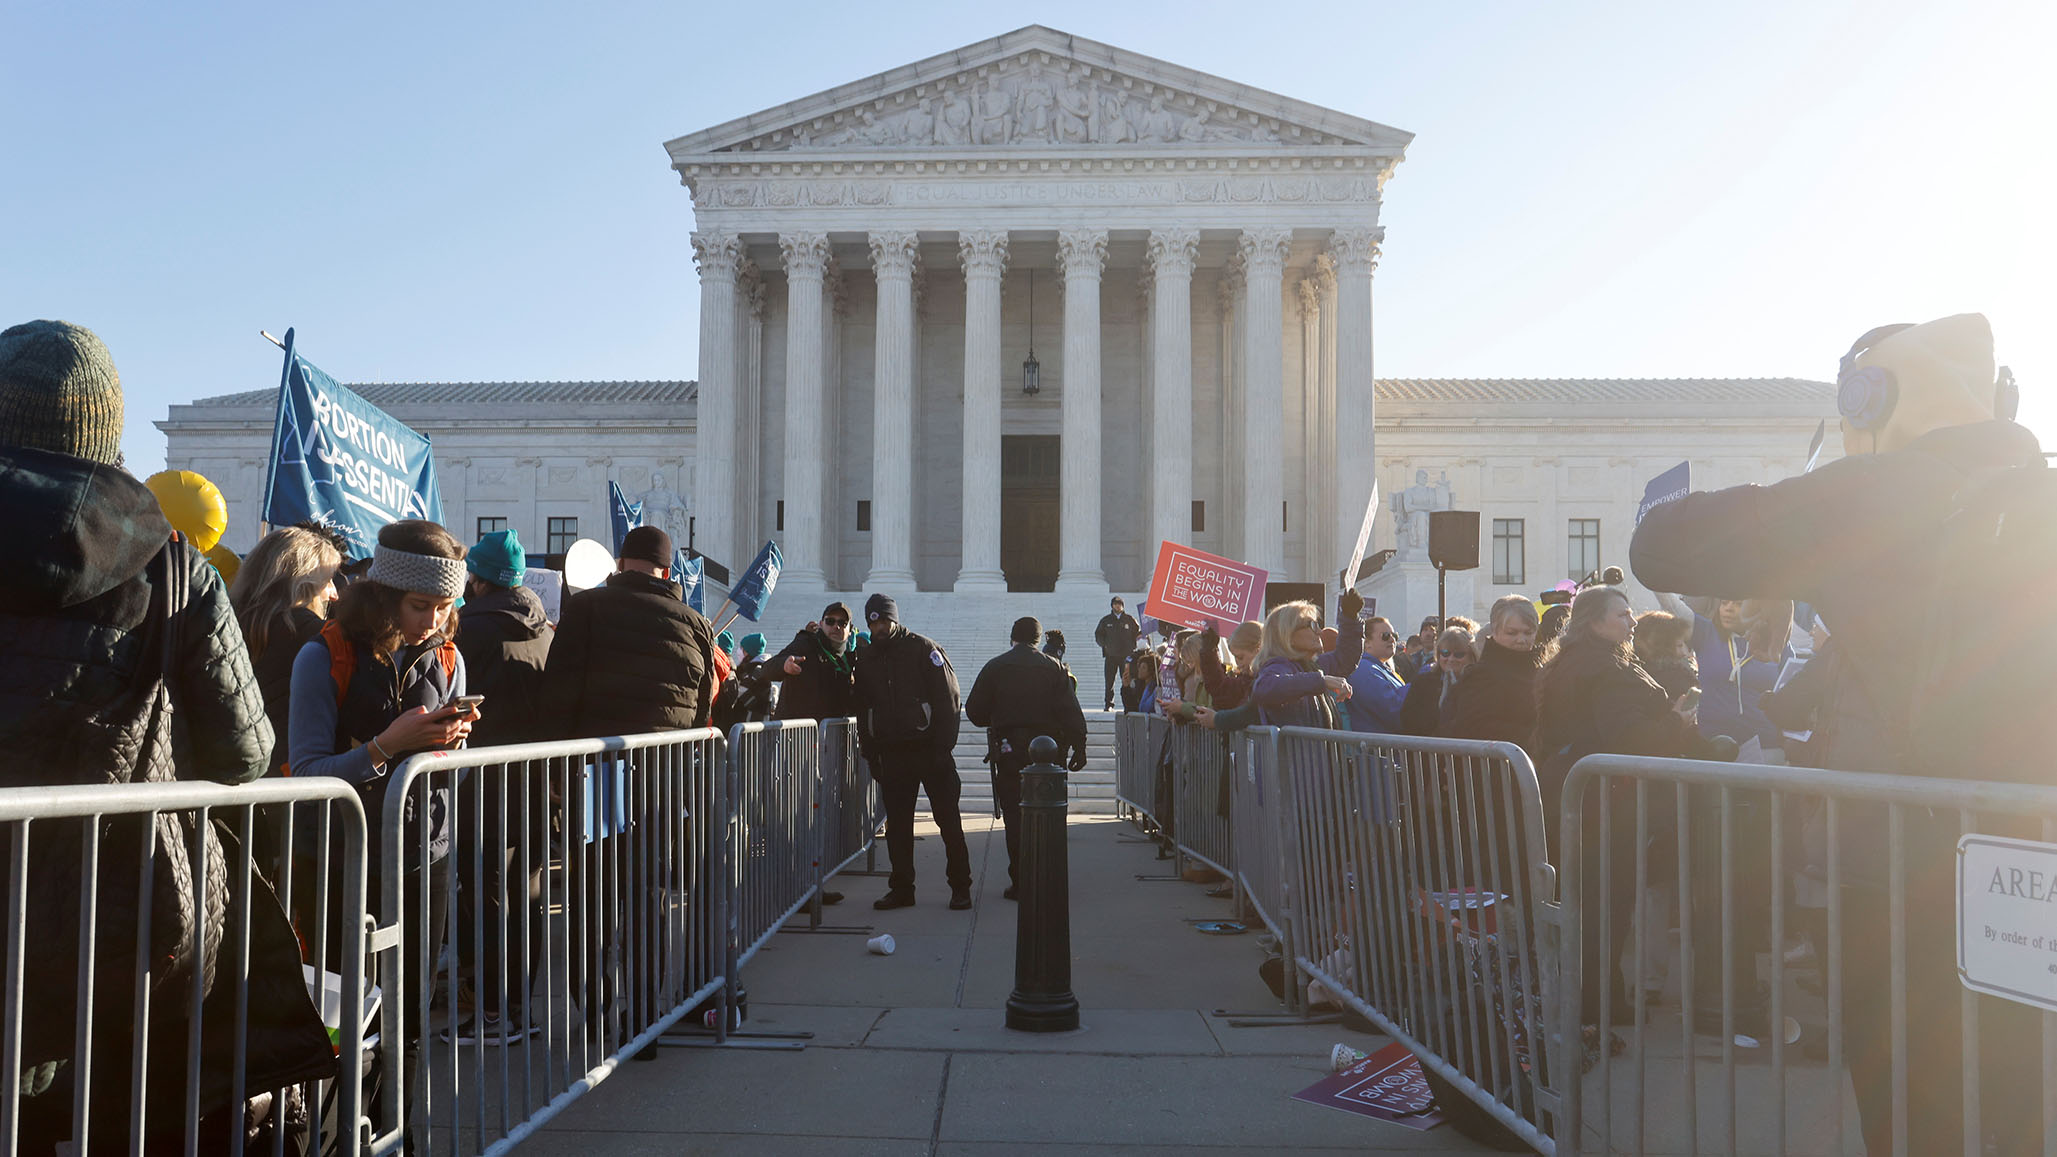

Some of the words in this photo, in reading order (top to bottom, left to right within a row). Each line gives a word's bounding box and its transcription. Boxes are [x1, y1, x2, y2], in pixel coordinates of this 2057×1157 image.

[905, 183, 968, 200] EQUAL
[977, 183, 1048, 200] JUSTICE
[1056, 183, 1120, 200] UNDER
[1127, 183, 1163, 199] LAW
[1641, 487, 1688, 513] EMPOWER
[1175, 573, 1223, 596] BEGINS
[1227, 589, 1241, 601] IN
[1178, 561, 1244, 588] EQUALITY
[1173, 587, 1188, 597] THE
[1189, 590, 1239, 614] WOMB
[1988, 865, 2057, 903] AREA
[1984, 925, 1997, 941] By
[2001, 931, 2028, 946] order
[2032, 936, 2045, 949] of
[1359, 1069, 1423, 1099] WOMB
